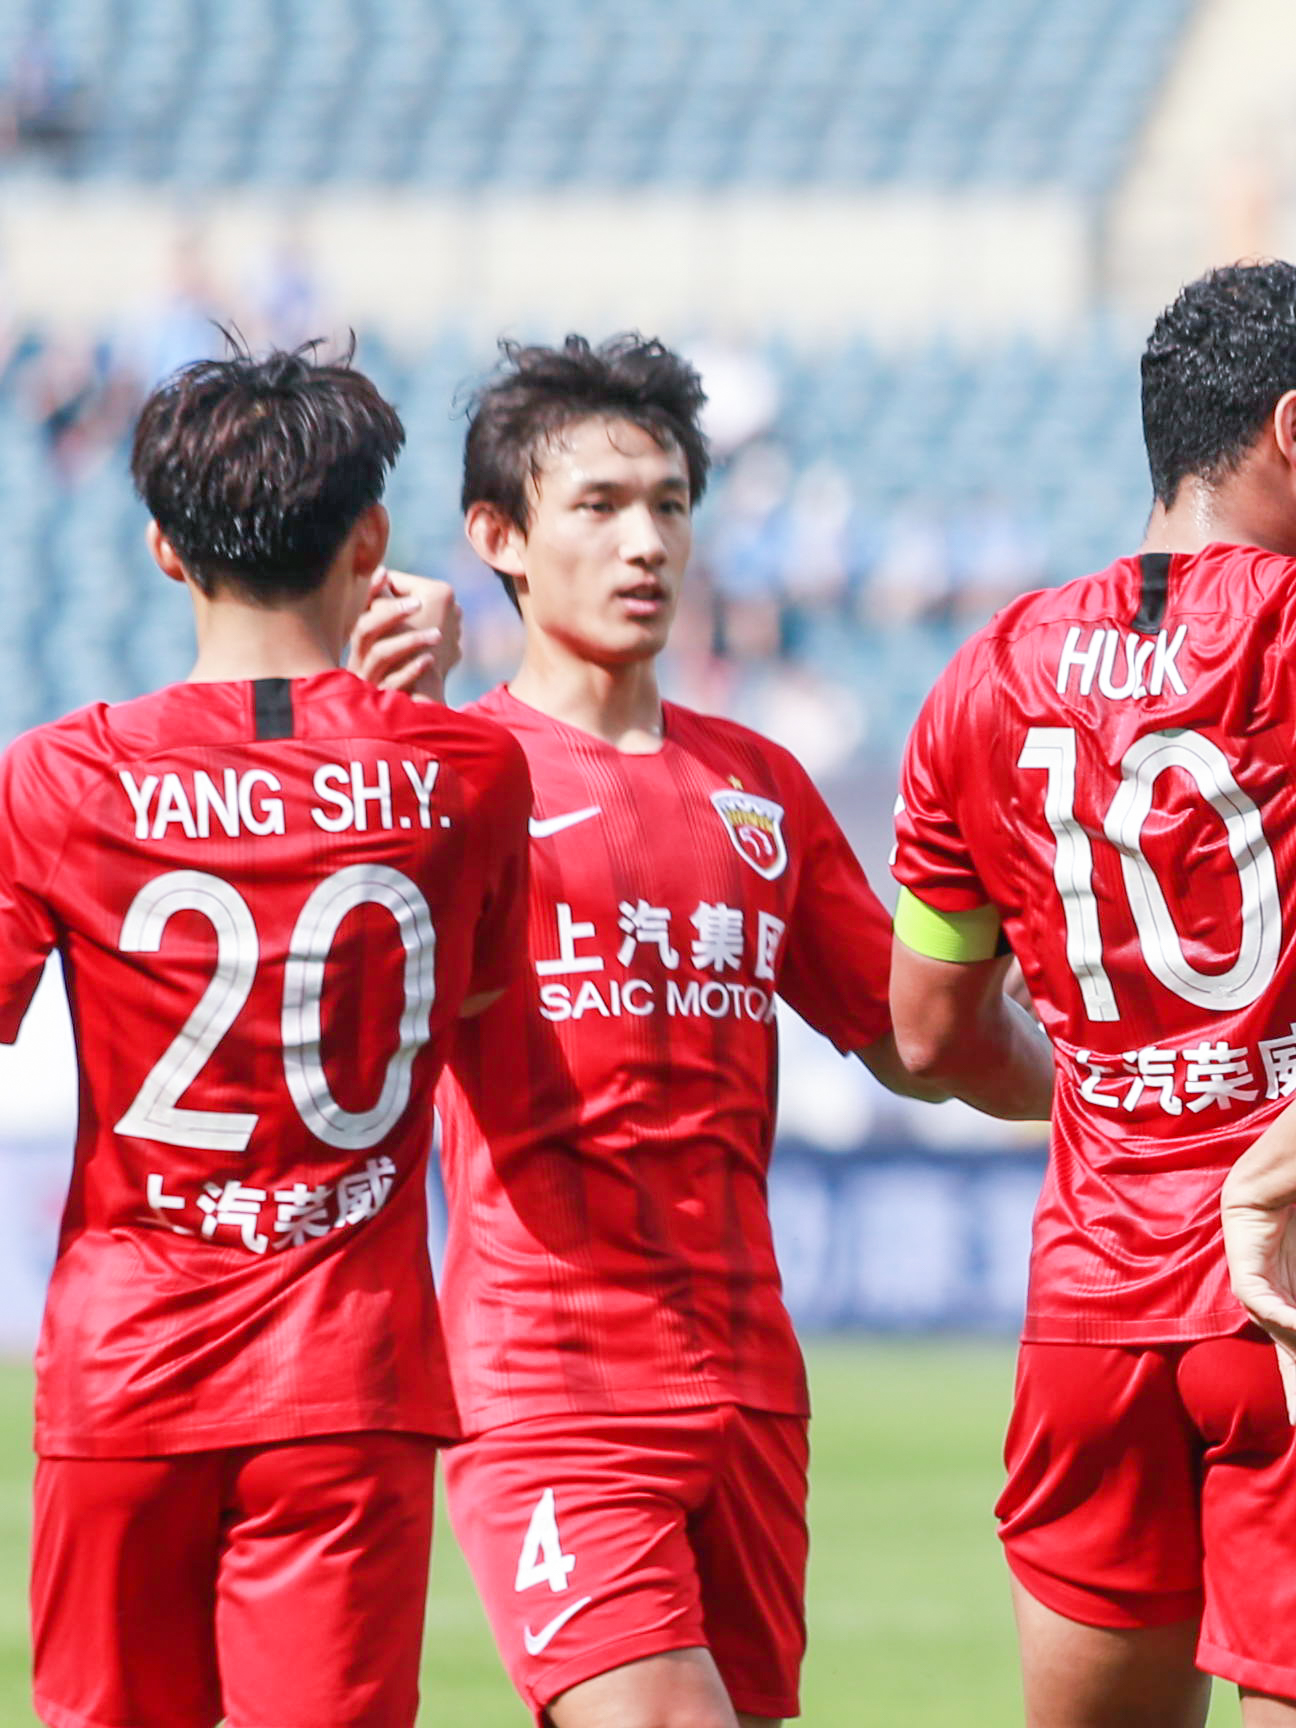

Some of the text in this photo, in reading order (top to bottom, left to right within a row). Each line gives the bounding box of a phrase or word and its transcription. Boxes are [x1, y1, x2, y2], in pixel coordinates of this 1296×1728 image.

[1056, 624, 1188, 700] HULK
[119, 760, 452, 839] YANG SH.Y.
[1018, 727, 1284, 1022] 10
[536, 899, 786, 980] 上汽集团
[114, 863, 437, 1151] 20
[539, 980, 655, 1021] SAIC
[515, 1487, 576, 1592] 4
